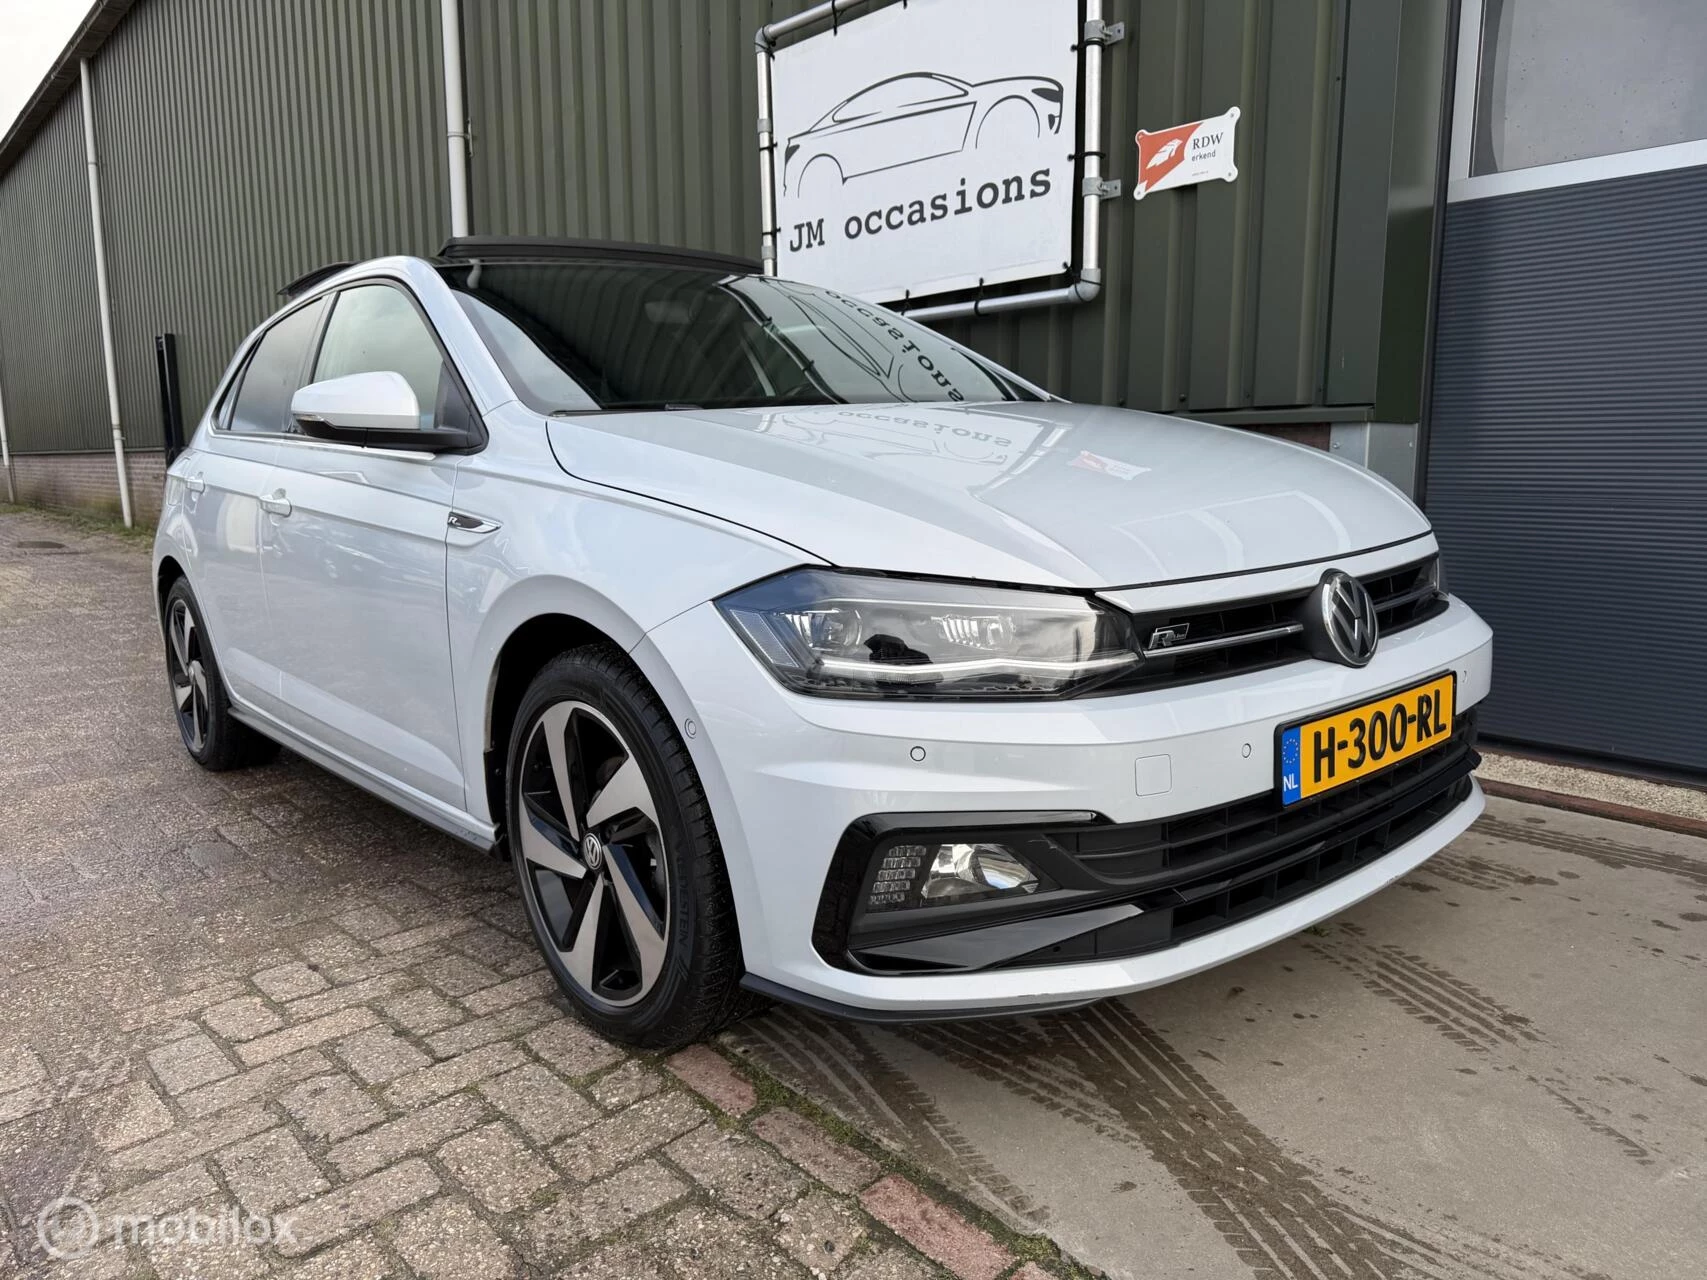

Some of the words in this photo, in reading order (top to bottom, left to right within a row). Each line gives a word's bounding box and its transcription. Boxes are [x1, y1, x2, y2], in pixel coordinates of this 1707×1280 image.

[1192, 131, 1224, 150] RDW
[1191, 149, 1217, 162] erkend
[789, 217, 826, 252] JM
[844, 168, 1052, 240] occasions
[1313, 688, 1447, 783] H-300-RL
[1282, 773, 1299, 792] NL
